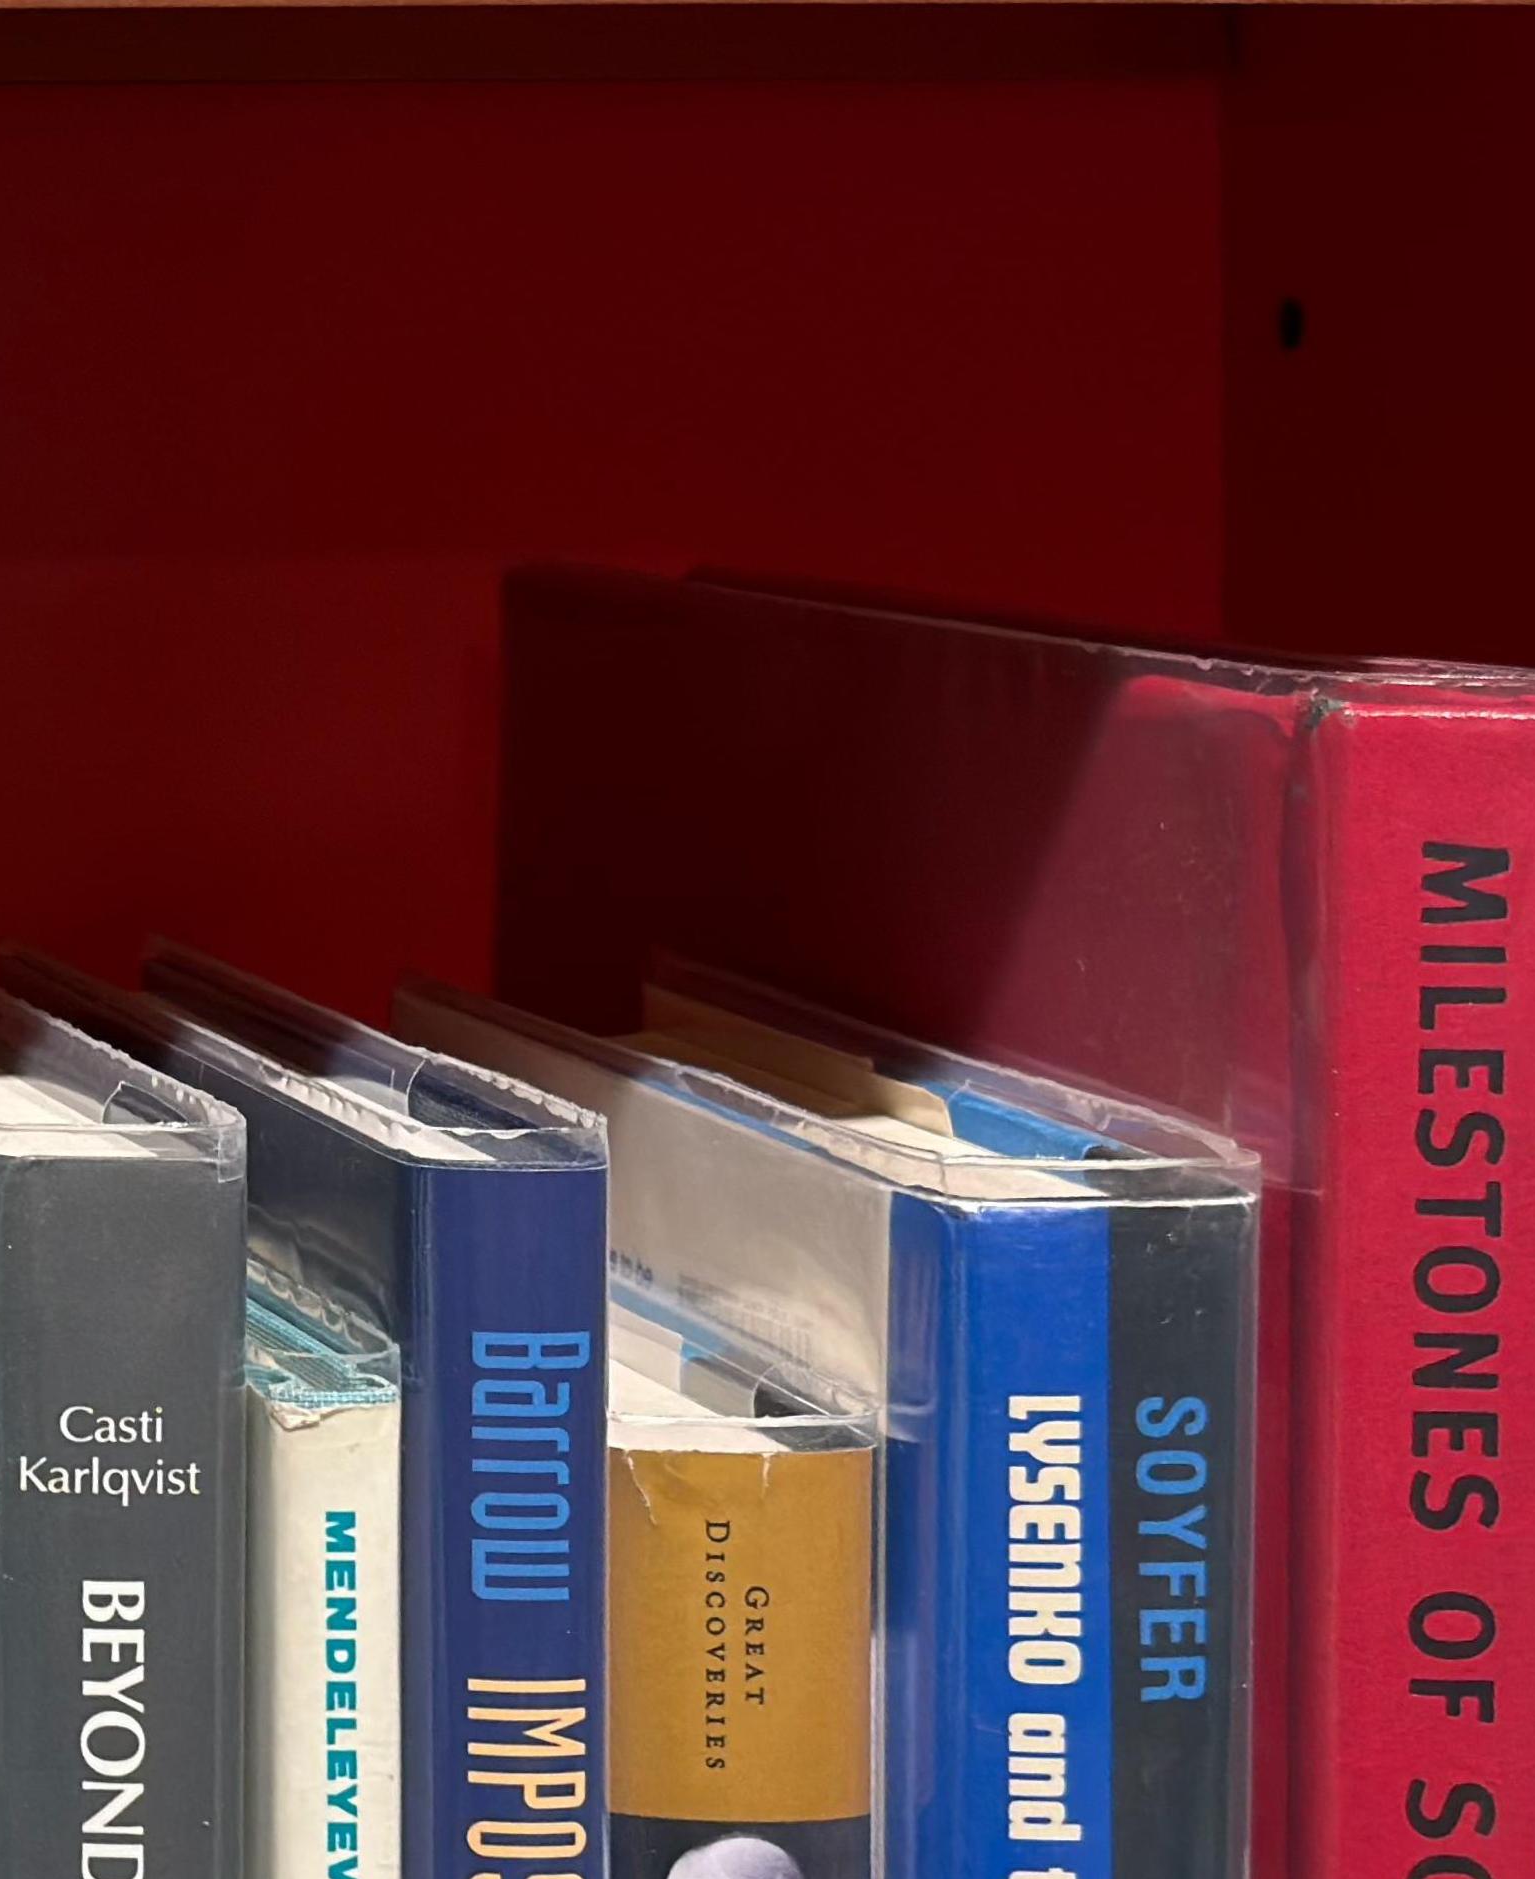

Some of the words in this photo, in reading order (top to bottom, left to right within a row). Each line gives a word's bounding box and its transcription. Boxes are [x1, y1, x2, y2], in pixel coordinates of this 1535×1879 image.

[1406, 841, 1509, 1531] MILESTONES
[19, 1454, 201, 1506] Karlqvist
[58, 1406, 163, 1445] Casti
[470, 1330, 590, 1600] Barrow
[706, 1520, 730, 1773] DISCOVERIES
[1138, 1398, 1207, 1704] SOYFER
[743, 1586, 767, 1710] GREAT
[1406, 1594, 1495, 1728] OF
